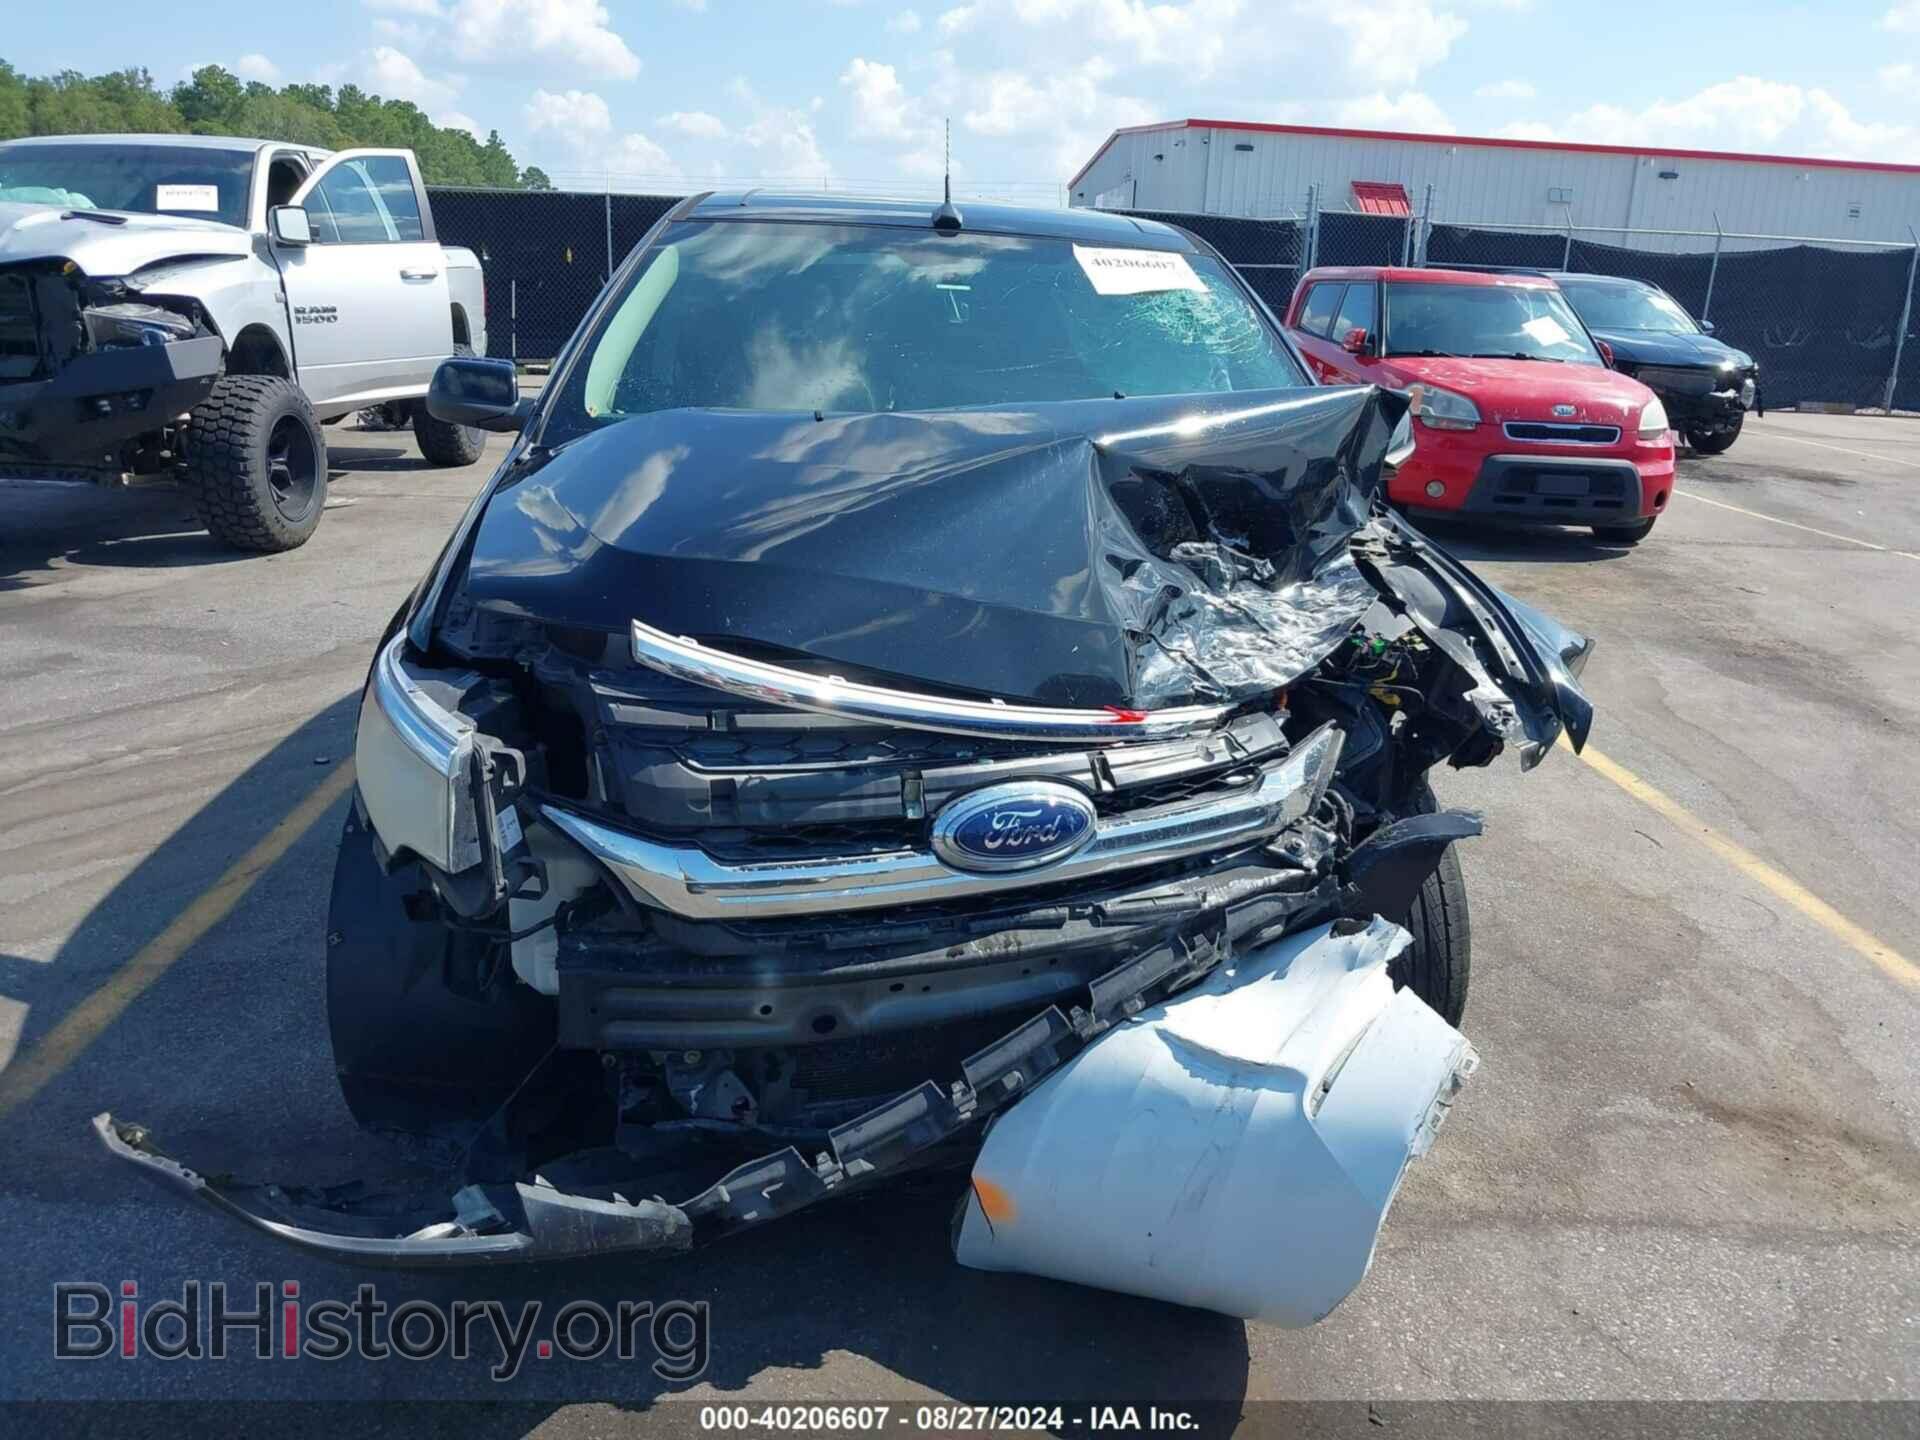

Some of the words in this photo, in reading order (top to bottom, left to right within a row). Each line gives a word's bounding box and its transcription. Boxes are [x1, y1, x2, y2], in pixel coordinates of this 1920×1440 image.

[293, 305, 338, 315] RAM
[294, 314, 339, 325] 1500
[983, 808, 1062, 849] Ford
